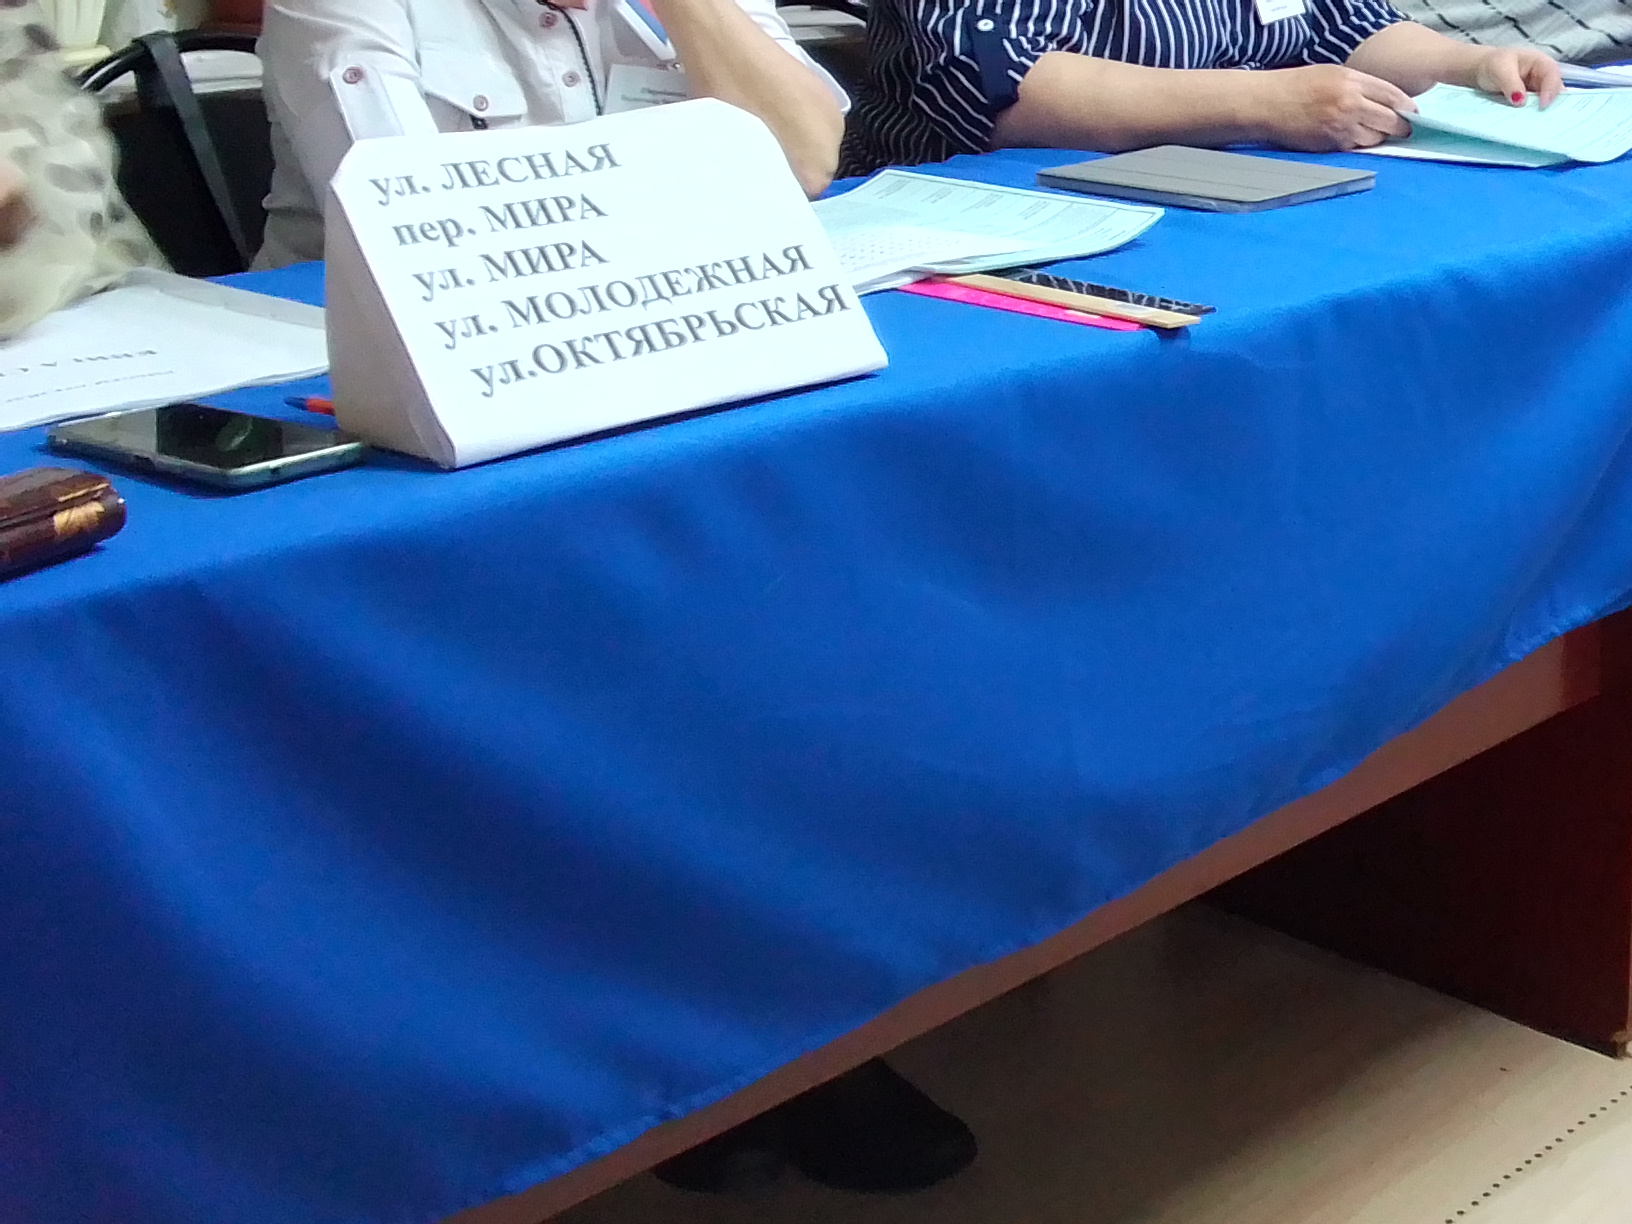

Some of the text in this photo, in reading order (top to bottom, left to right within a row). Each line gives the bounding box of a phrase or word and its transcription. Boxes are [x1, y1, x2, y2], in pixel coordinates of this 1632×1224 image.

[368, 143, 622, 206] ул. ЛЕСНАЯ
[392, 193, 609, 248] пер. МИРА
[413, 239, 610, 302] ул. МИРА
[434, 244, 814, 350] ул. МОЛОДЕЖНАЯ
